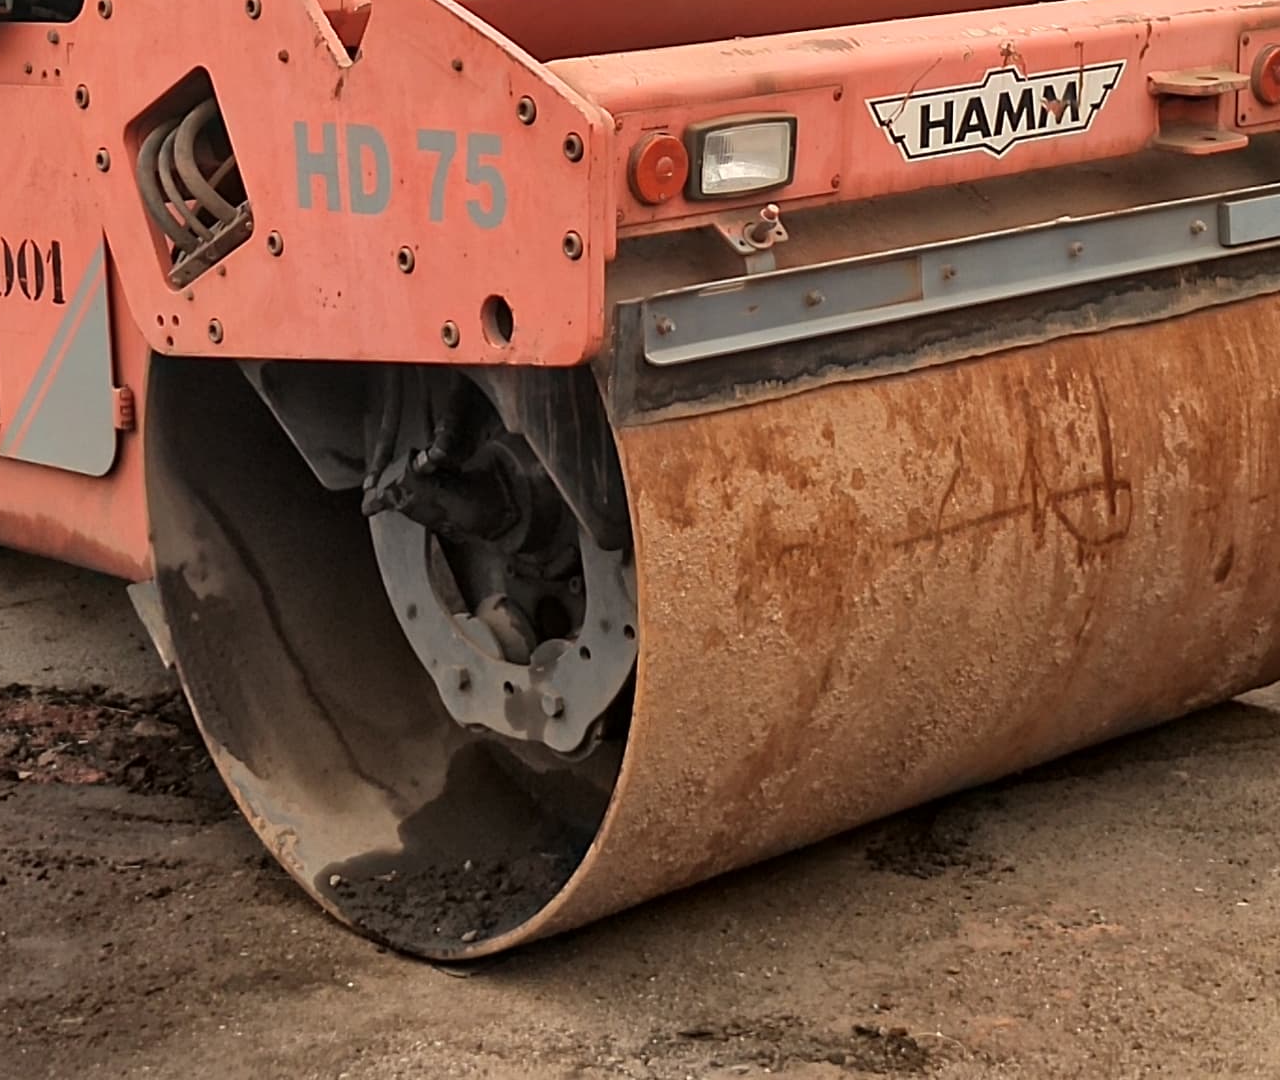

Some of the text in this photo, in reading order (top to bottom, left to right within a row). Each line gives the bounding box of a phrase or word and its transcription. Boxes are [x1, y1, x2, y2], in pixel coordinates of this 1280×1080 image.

[919, 81, 1080, 149] HAMM
[293, 120, 507, 229] HD 75
